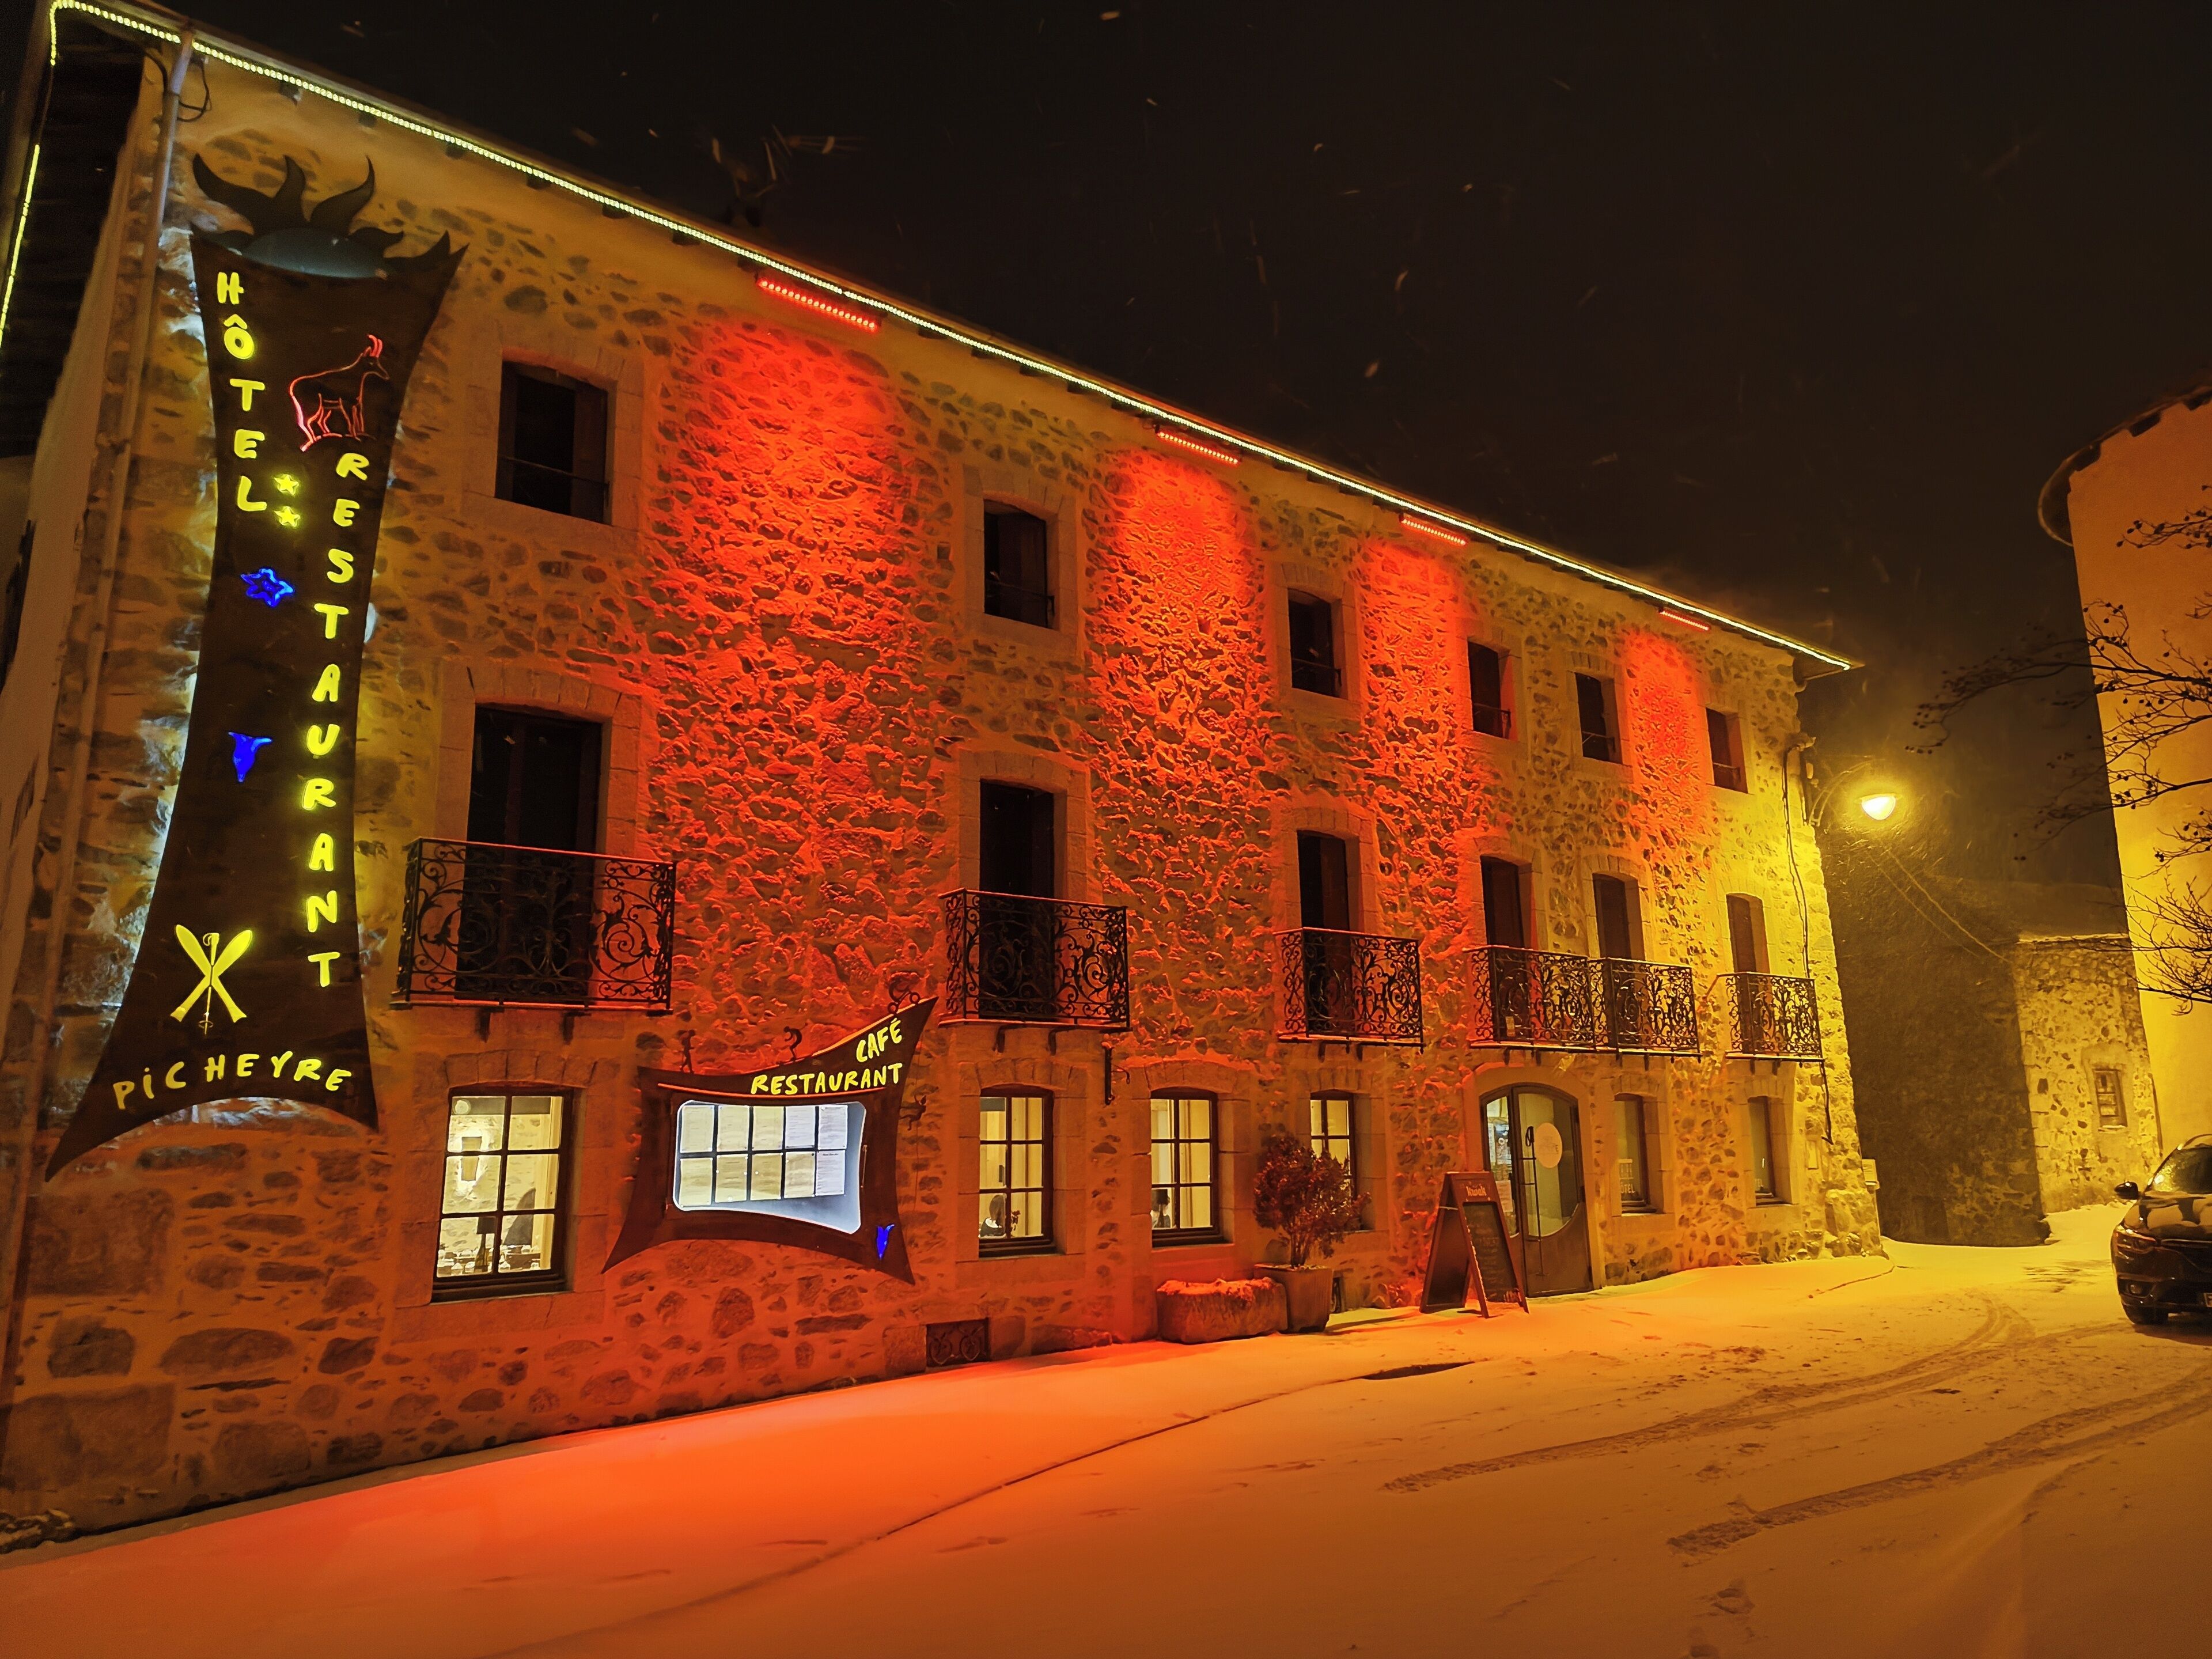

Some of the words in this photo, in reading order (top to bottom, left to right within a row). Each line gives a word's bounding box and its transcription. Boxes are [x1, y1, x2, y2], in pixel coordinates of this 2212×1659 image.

[217, 271, 267, 513] HÔTEL
[298, 453, 369, 987] RESTAURANT
[856, 1018, 903, 1063] CAFÉ
[750, 1063, 903, 1095] RESTAURANT
[1620, 1181, 1635, 1194] ÔTEL
